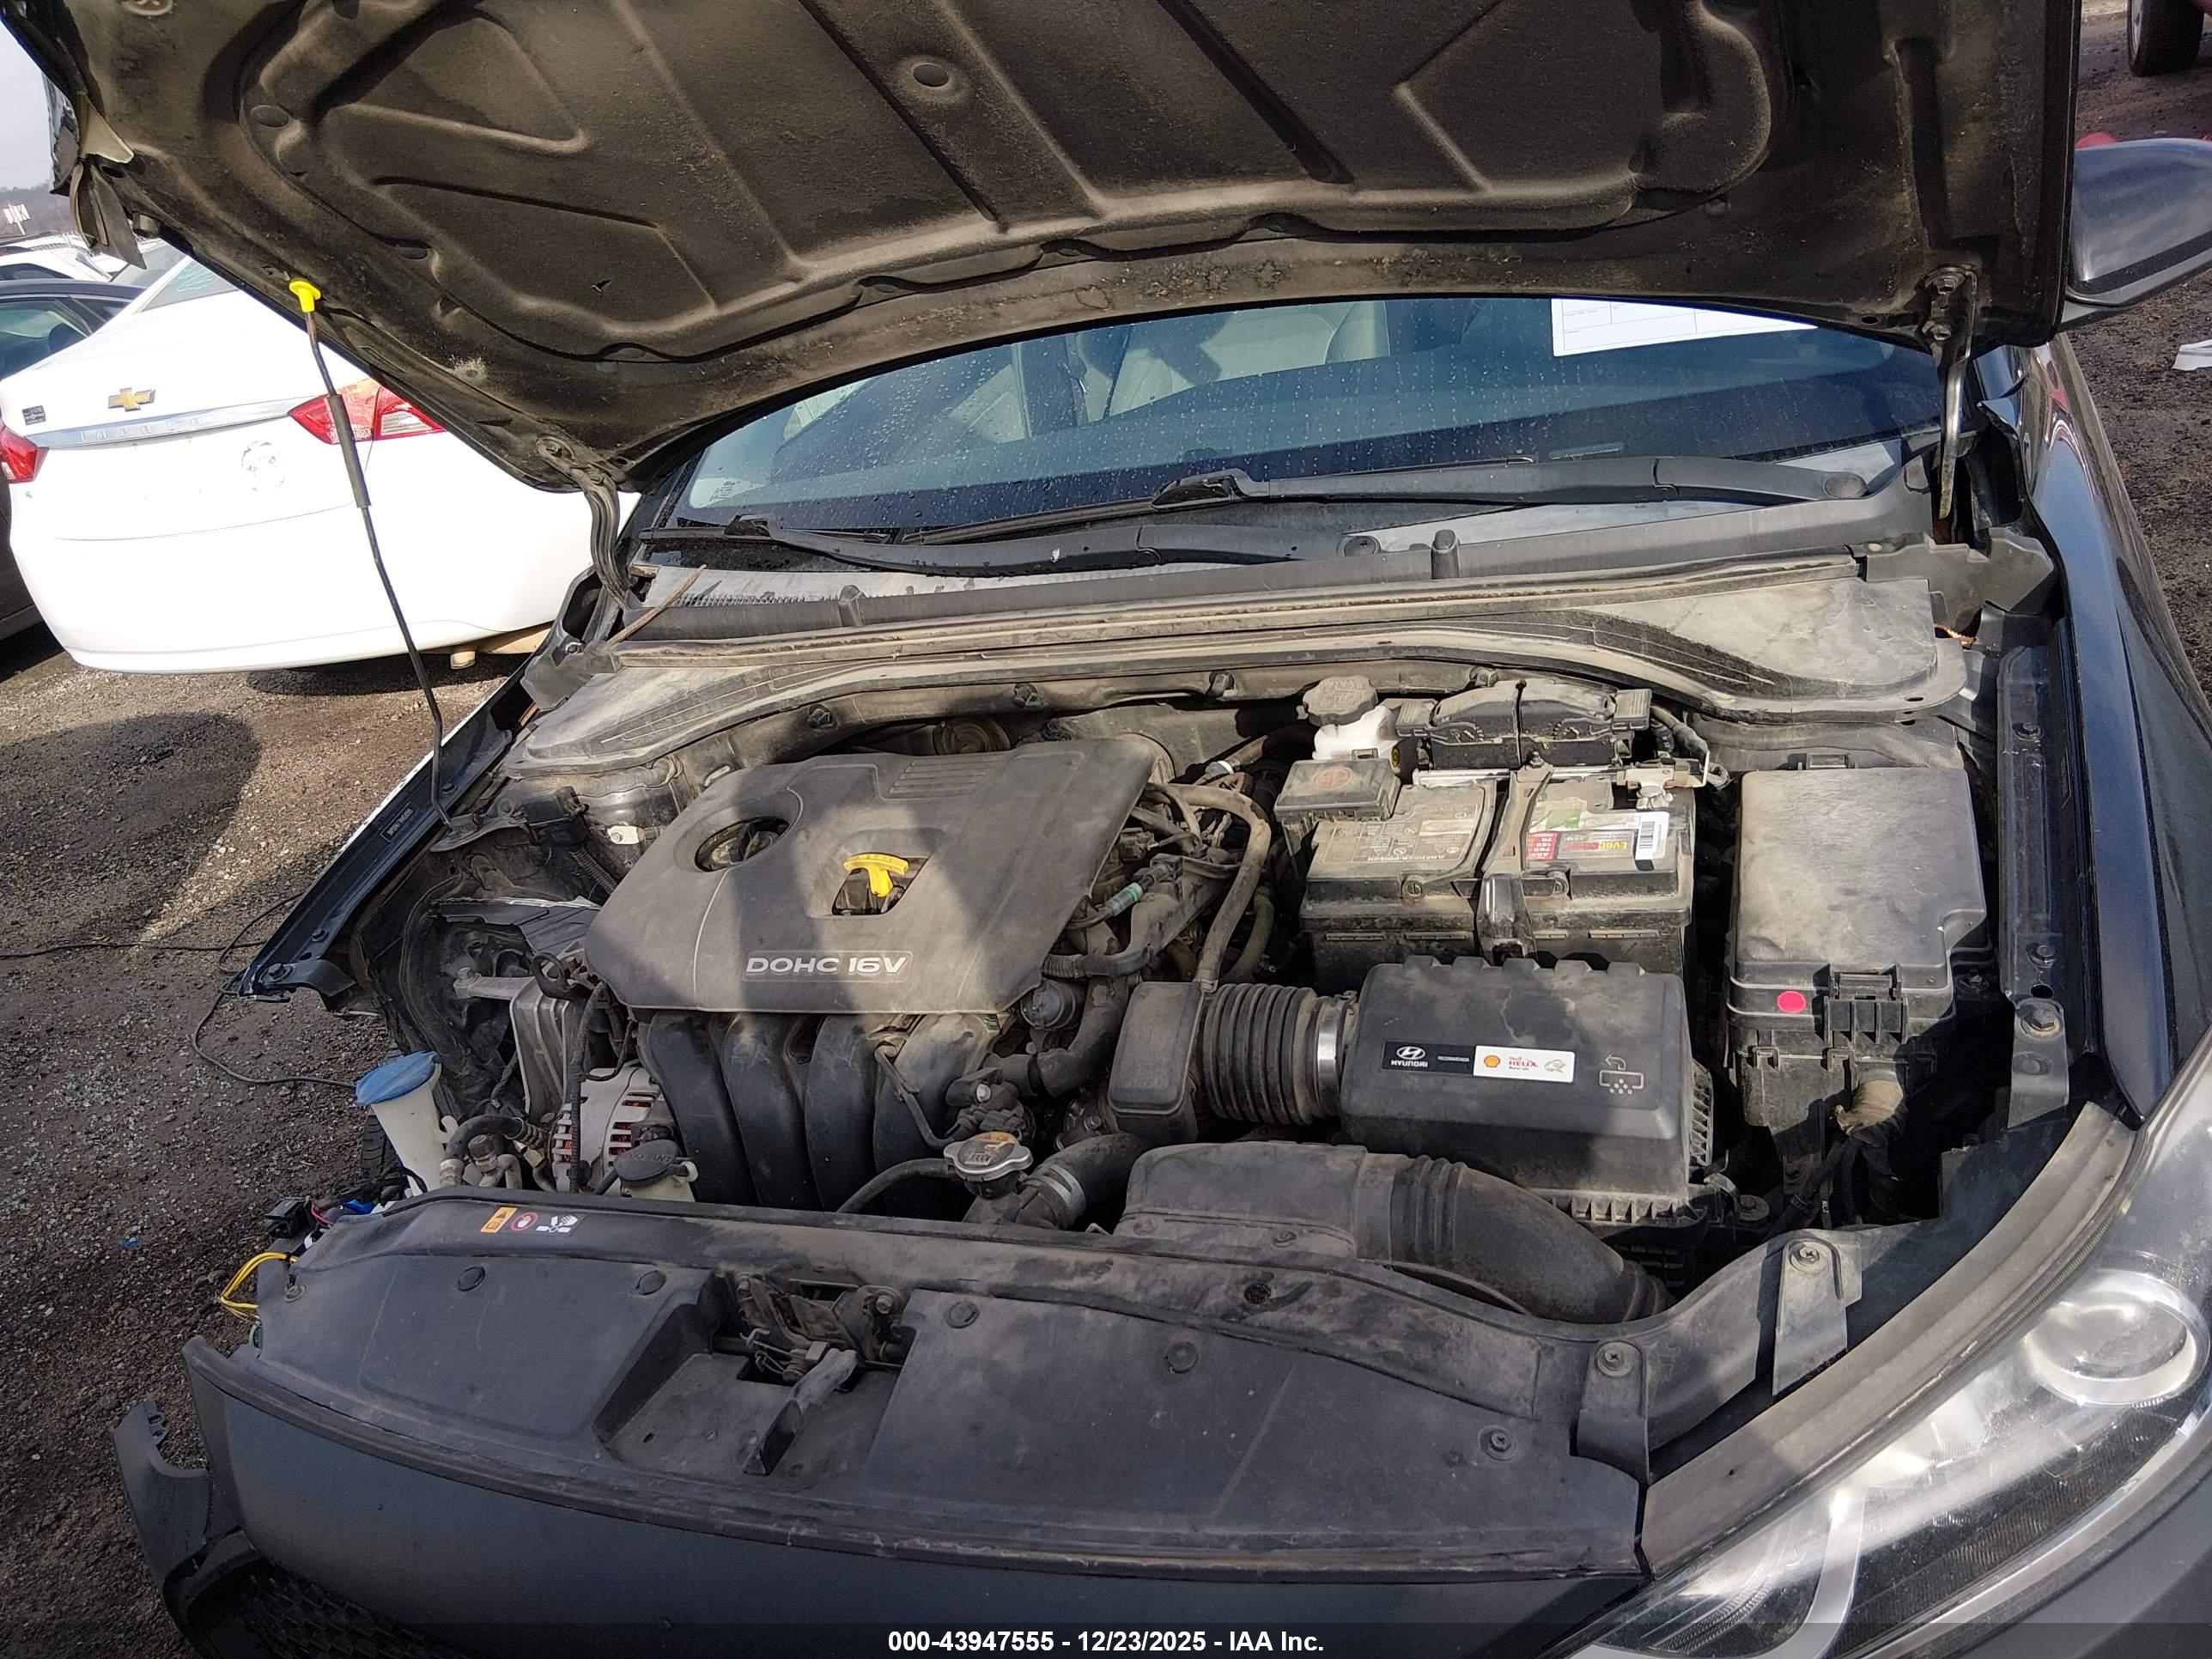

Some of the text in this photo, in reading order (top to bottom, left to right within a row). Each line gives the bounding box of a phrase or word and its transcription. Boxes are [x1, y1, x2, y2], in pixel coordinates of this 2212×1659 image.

[746, 957, 907, 973] DOHC 16V
[1391, 1060, 1428, 1068] HYUNDAI
